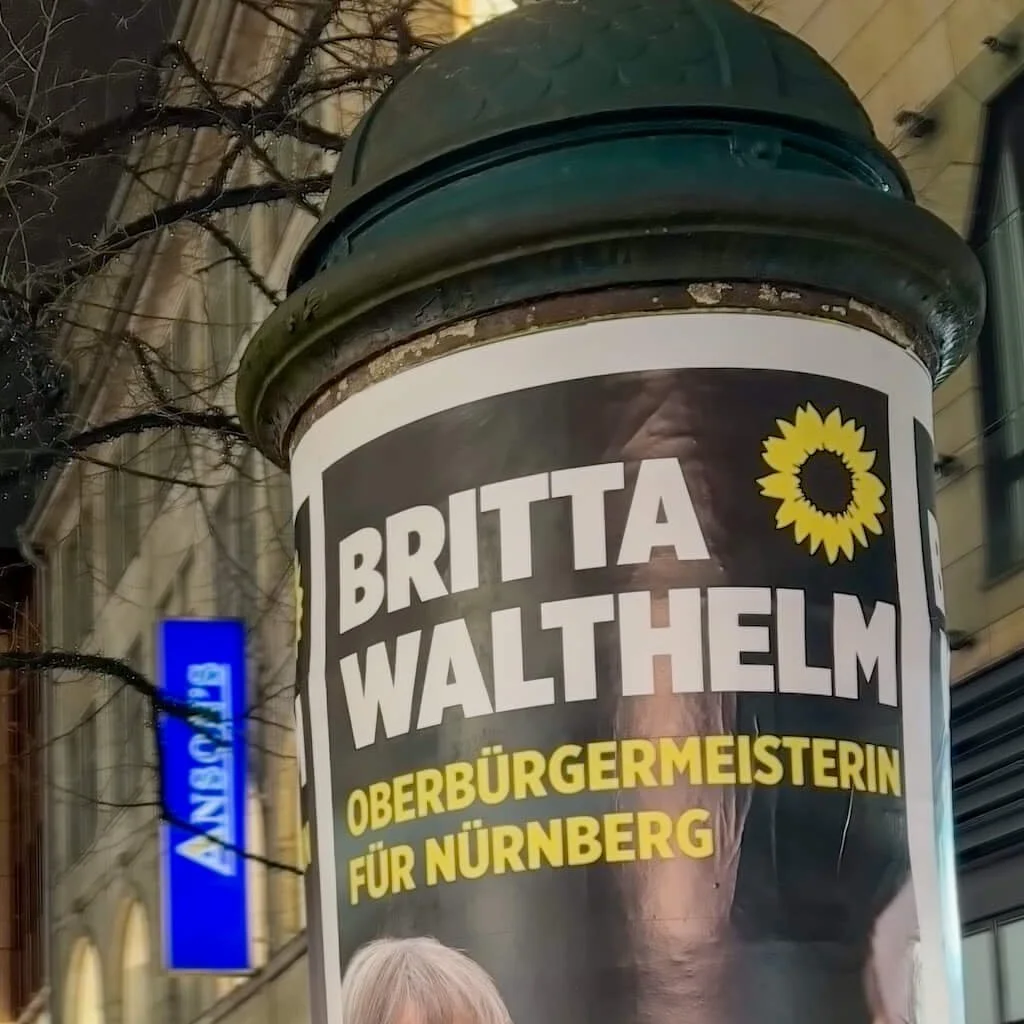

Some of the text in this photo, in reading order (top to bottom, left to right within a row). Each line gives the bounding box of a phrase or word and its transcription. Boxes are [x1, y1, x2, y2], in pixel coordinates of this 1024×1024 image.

[338, 457, 712, 635] BRITTA
[339, 587, 898, 751] WALTHELM
[346, 735, 902, 837] OBERBÜRGERMEISTERIN
[348, 808, 714, 905] FÜR NÜRNBERG
